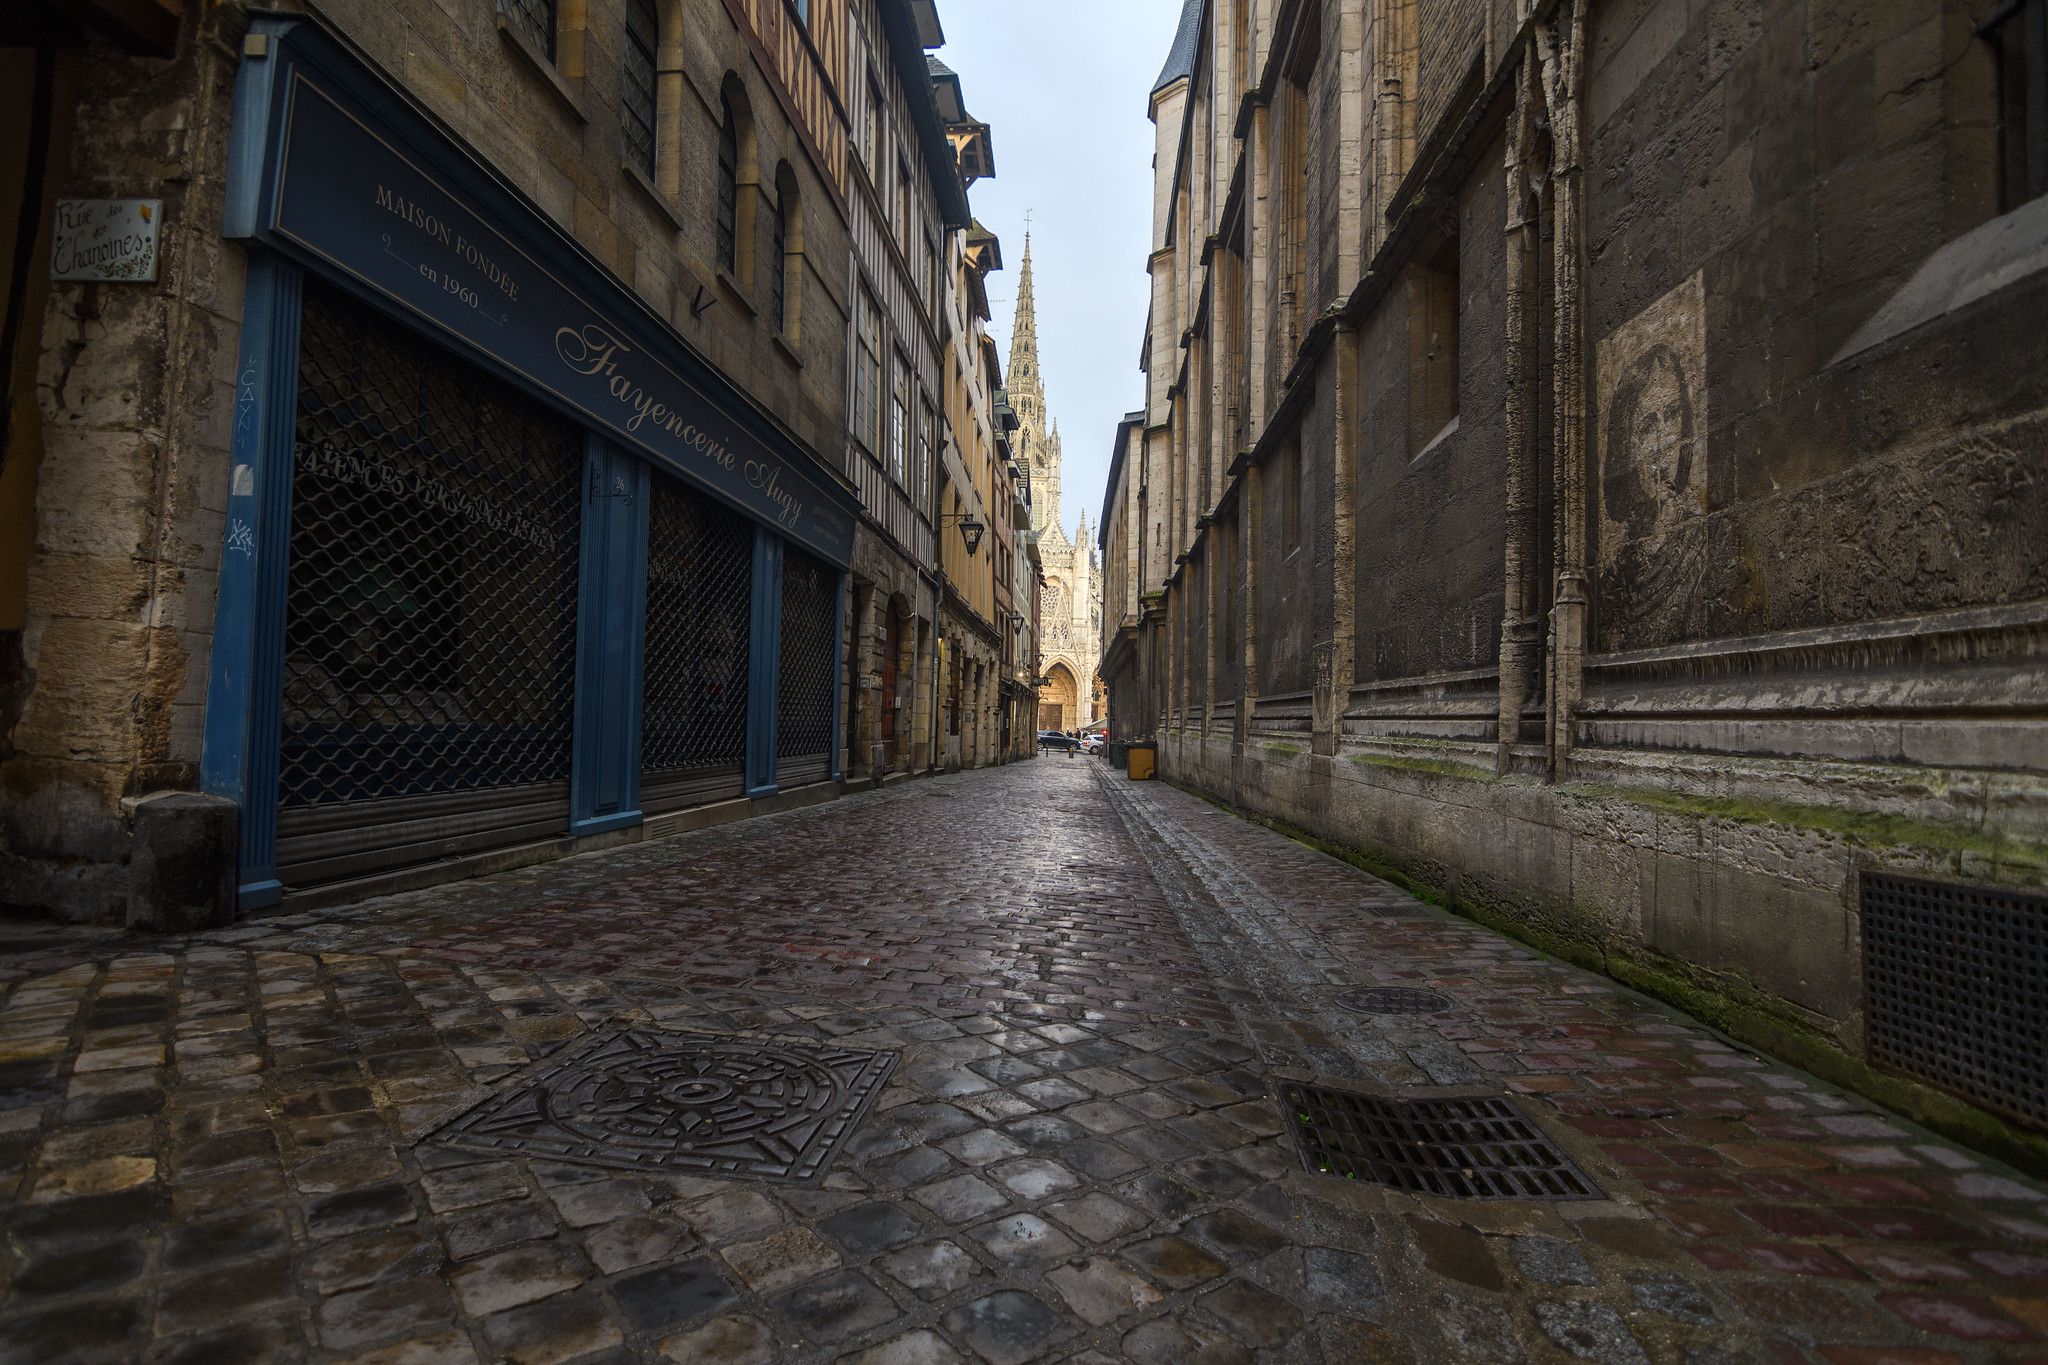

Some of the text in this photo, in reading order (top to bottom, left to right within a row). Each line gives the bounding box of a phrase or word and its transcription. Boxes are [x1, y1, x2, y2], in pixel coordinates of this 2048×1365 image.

[57, 201, 123, 233] Rue des
[54, 231, 143, 275] Chanoines
[375, 184, 519, 301] MAISON FONDÉE
[419, 263, 478, 309] en 1960
[555, 324, 802, 529] Fayencerie Augy
